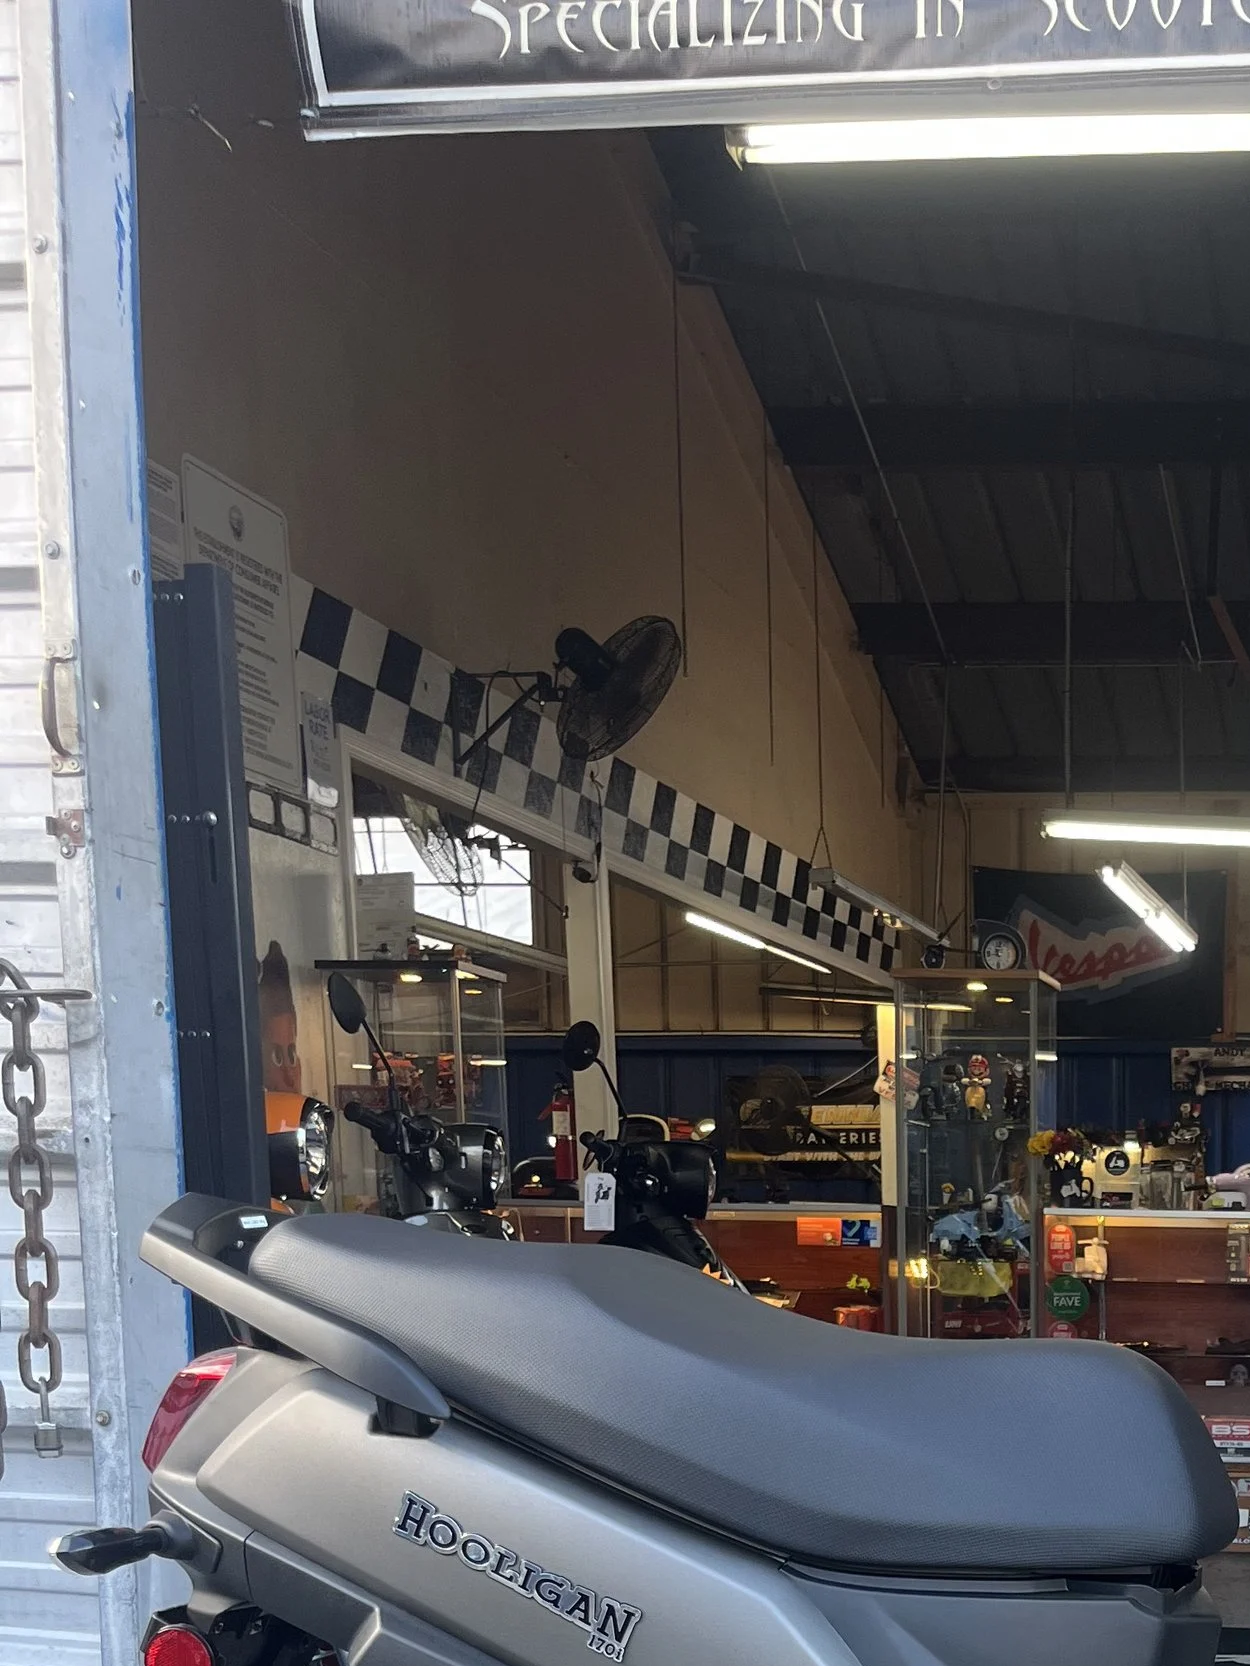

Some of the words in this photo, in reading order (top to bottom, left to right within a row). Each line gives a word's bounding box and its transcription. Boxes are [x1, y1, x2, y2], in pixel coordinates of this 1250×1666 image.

[470, 0, 865, 59] SPECIALIZING
[1053, 1296, 1081, 1307] FAVE
[395, 1493, 640, 1646] HOOLIGAN
[588, 1635, 625, 1661] 170i
